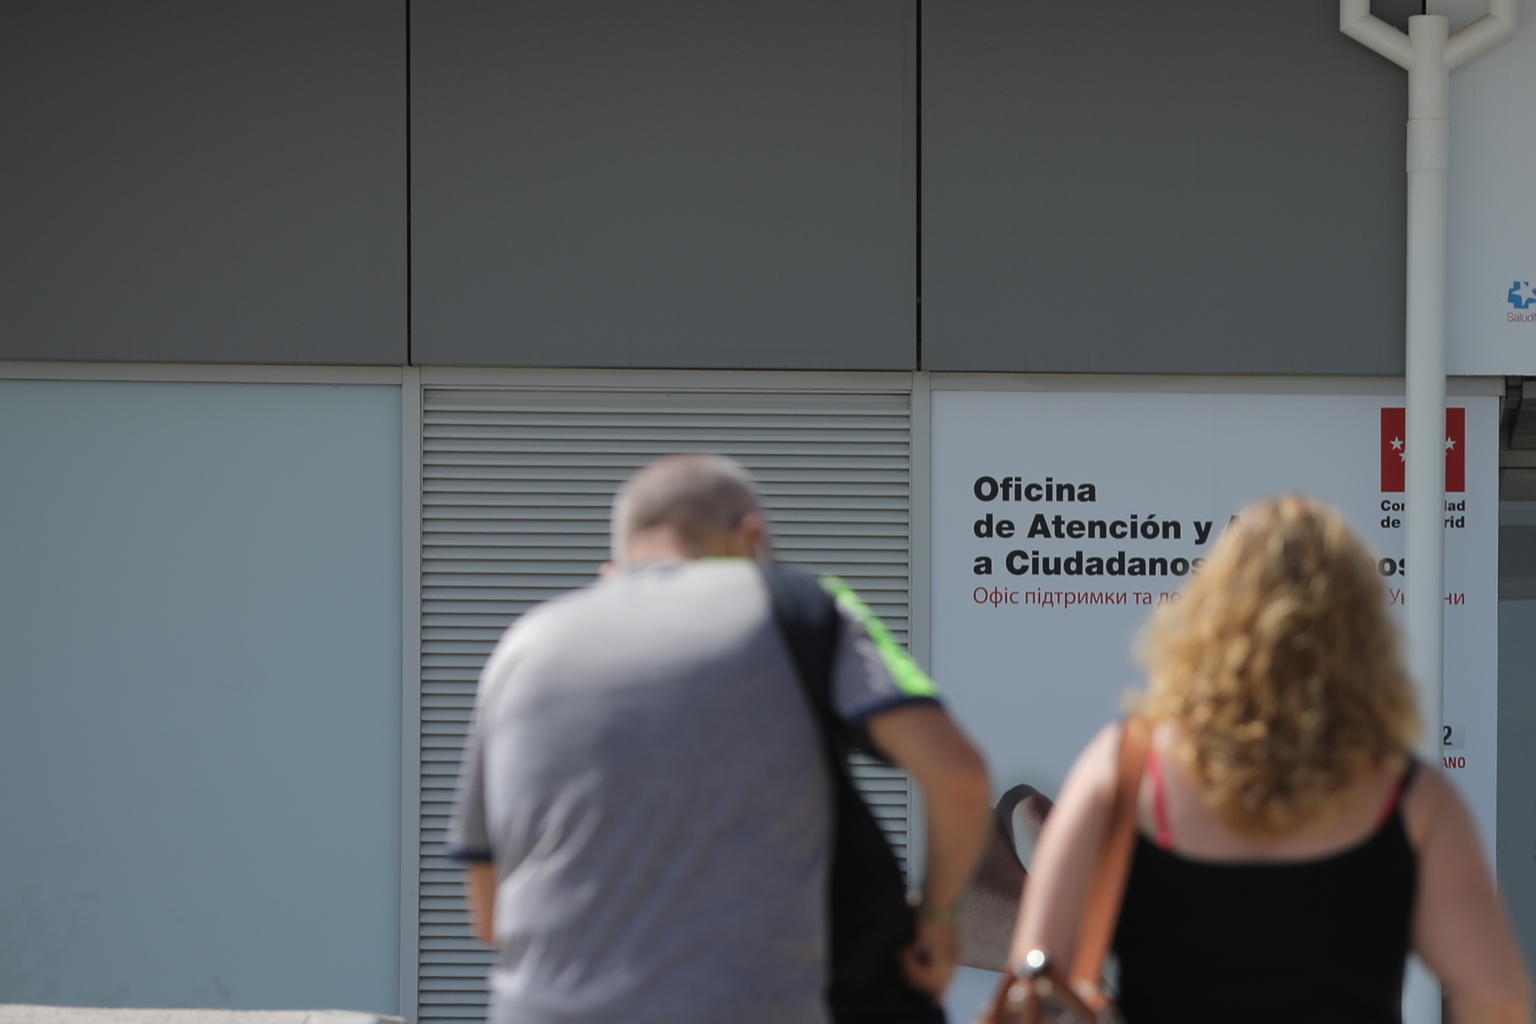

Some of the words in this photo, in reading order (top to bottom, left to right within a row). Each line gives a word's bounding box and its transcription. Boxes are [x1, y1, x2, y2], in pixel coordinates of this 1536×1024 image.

[973, 475, 1097, 503] Oficina
[973, 513, 1016, 539] de
[1026, 513, 1182, 540] Atención
[1192, 520, 1213, 545] y
[1380, 515, 1401, 529] de
[972, 555, 993, 576] a
[973, 586, 1019, 609] Офіс
[1025, 586, 1128, 609] підтримки
[1132, 591, 1152, 605] та
